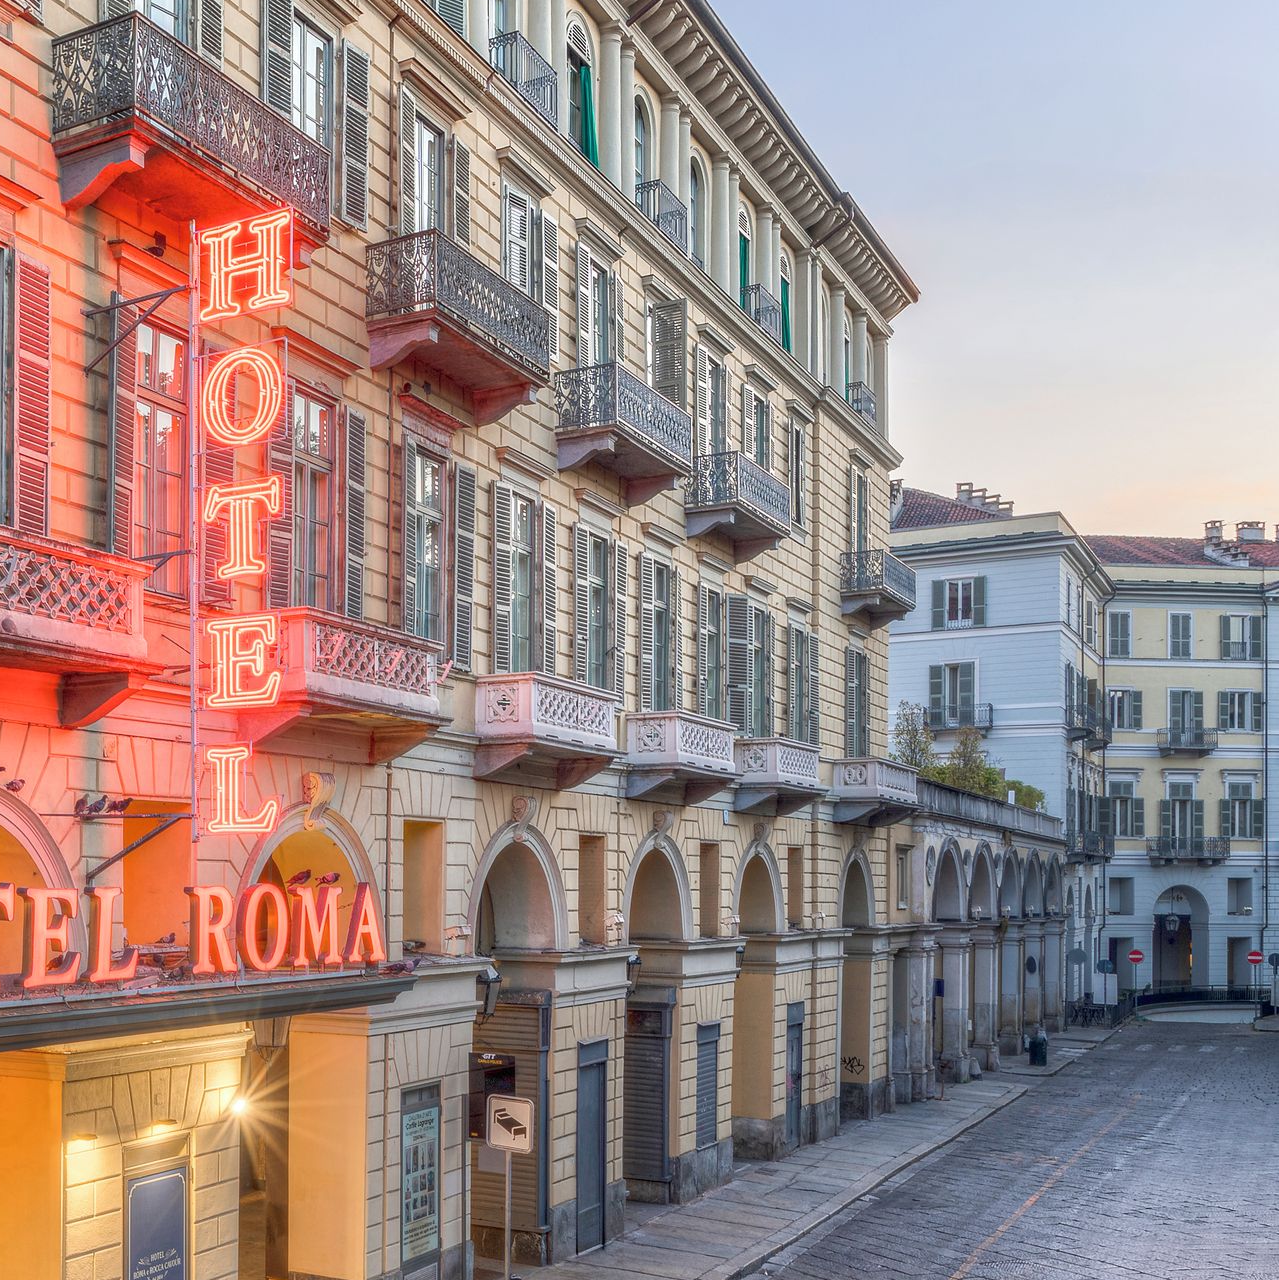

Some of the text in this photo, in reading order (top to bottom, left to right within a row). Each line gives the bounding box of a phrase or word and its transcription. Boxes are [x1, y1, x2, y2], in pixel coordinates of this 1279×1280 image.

[199, 208, 292, 835] HOTEL
[184, 881, 386, 976] ROMA
[150, 1251, 165, 1262] HOTEL
